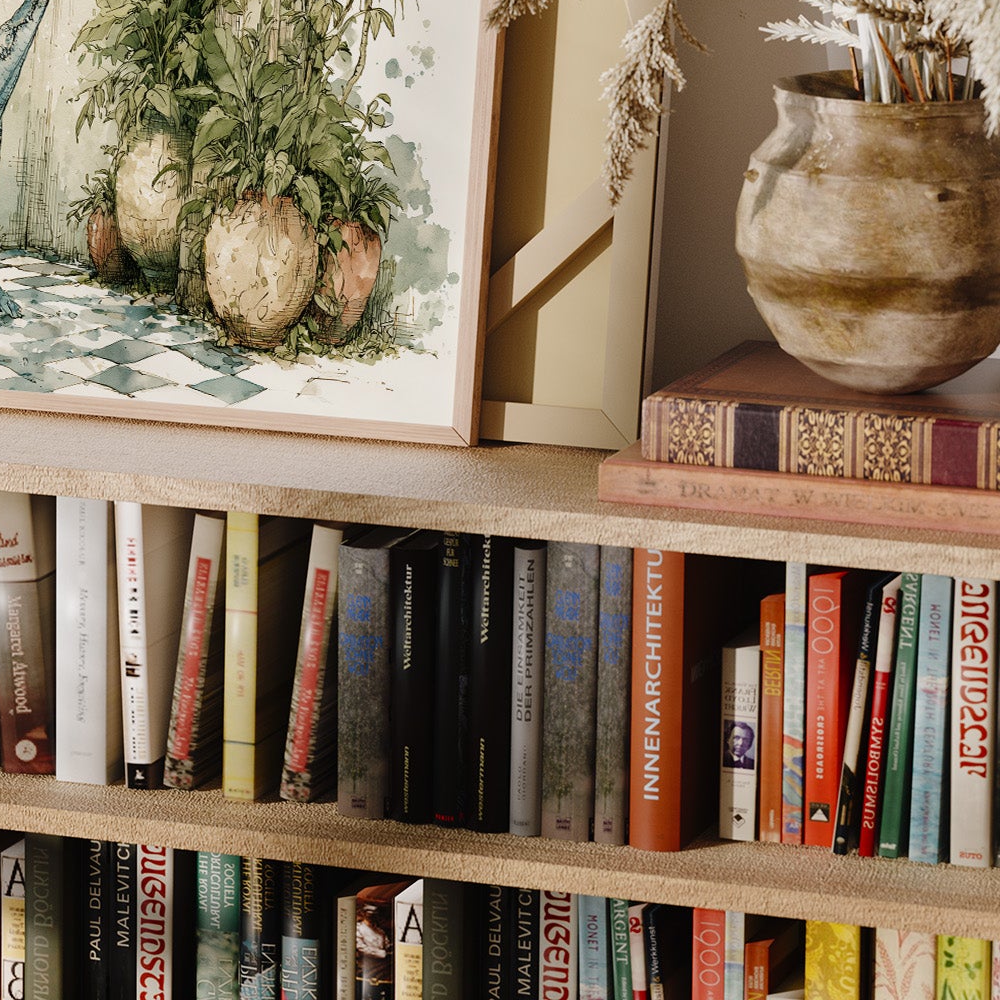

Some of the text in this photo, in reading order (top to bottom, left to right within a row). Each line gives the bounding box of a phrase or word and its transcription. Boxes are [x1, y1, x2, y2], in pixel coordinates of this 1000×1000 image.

[6, 594, 32, 714] Margaret Atwood
[402, 563, 414, 671] Weltarchitektur
[515, 572, 527, 723] DIE EINSAMKEIT
[524, 558, 536, 723] DER PRIMZAHLEN
[403, 746, 411, 814] westermann
[477, 737, 487, 821] westermann
[89, 917, 102, 962] PAUL
[587, 914, 600, 952] MONET
[650, 926, 660, 976] Werkkunst
[694, 920, 721, 988] 1900
